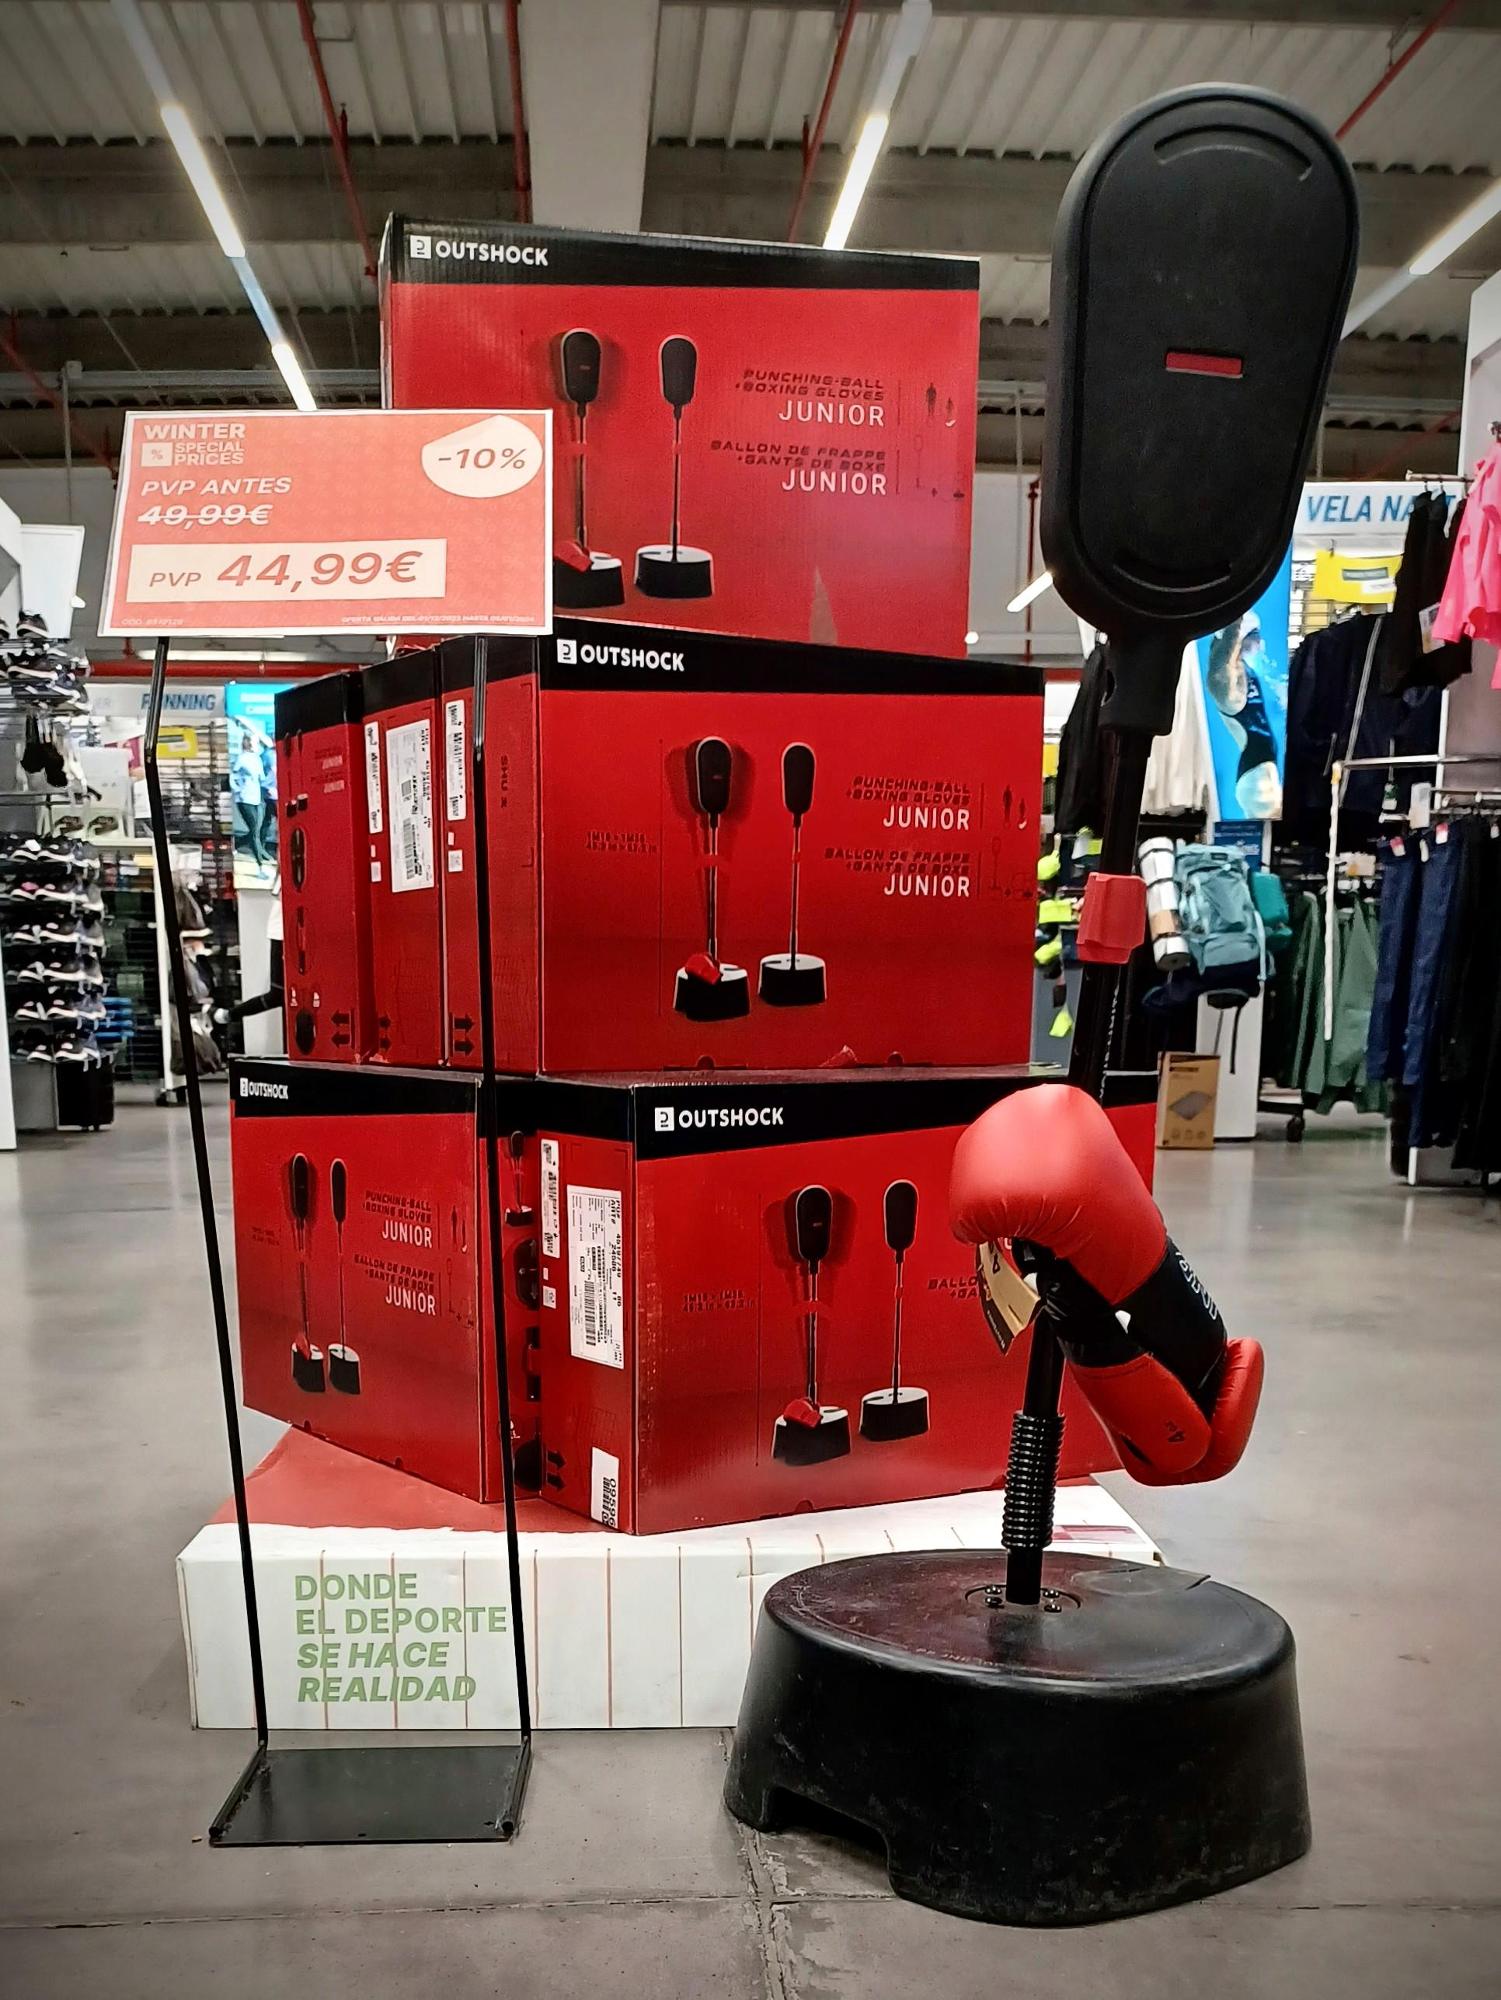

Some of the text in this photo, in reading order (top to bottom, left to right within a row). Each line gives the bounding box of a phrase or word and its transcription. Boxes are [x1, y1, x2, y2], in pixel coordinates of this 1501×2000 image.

[435, 240, 549, 267] OUTSHOCK
[815, 387, 885, 401] GLOVES
[778, 400, 885, 427] JUNIOR
[143, 423, 246, 440] WINTER
[174, 441, 245, 453] SPECIAL
[174, 452, 245, 466] PRICES
[438, 448, 527, 470] -10%
[710, 440, 886, 461] BALLON DE FRAPPE
[810, 458, 832, 470] DE
[839, 460, 886, 473] BOXE
[140, 477, 293, 497] PVP ANTES
[781, 468, 887, 495] JUNIOR
[137, 503, 274, 530] 49,99€
[1306, 494, 1372, 523] VELA
[149, 550, 424, 593] PVP 44,99€
[580, 644, 685, 672] OUTSHOCK
[141, 692, 217, 711] RNNING
[914, 793, 970, 806] GLOVES
[882, 805, 970, 831] JUNIOR
[824, 847, 884, 861] BALLON
[883, 873, 970, 898] JUNIOR
[249, 1081, 289, 1100] OUTSHOCK
[678, 1106, 785, 1129] OUTSHOCK
[381, 1219, 433, 1249] JUNIOR
[927, 1275, 978, 1290] BALLO
[385, 1284, 436, 1316] JUNIOR
[294, 1573, 418, 1601] DONDE
[296, 1606, 508, 1635] EL DEPORTE
[296, 1641, 450, 1669] SE HACE
[297, 1675, 477, 1703] REALIDAD
